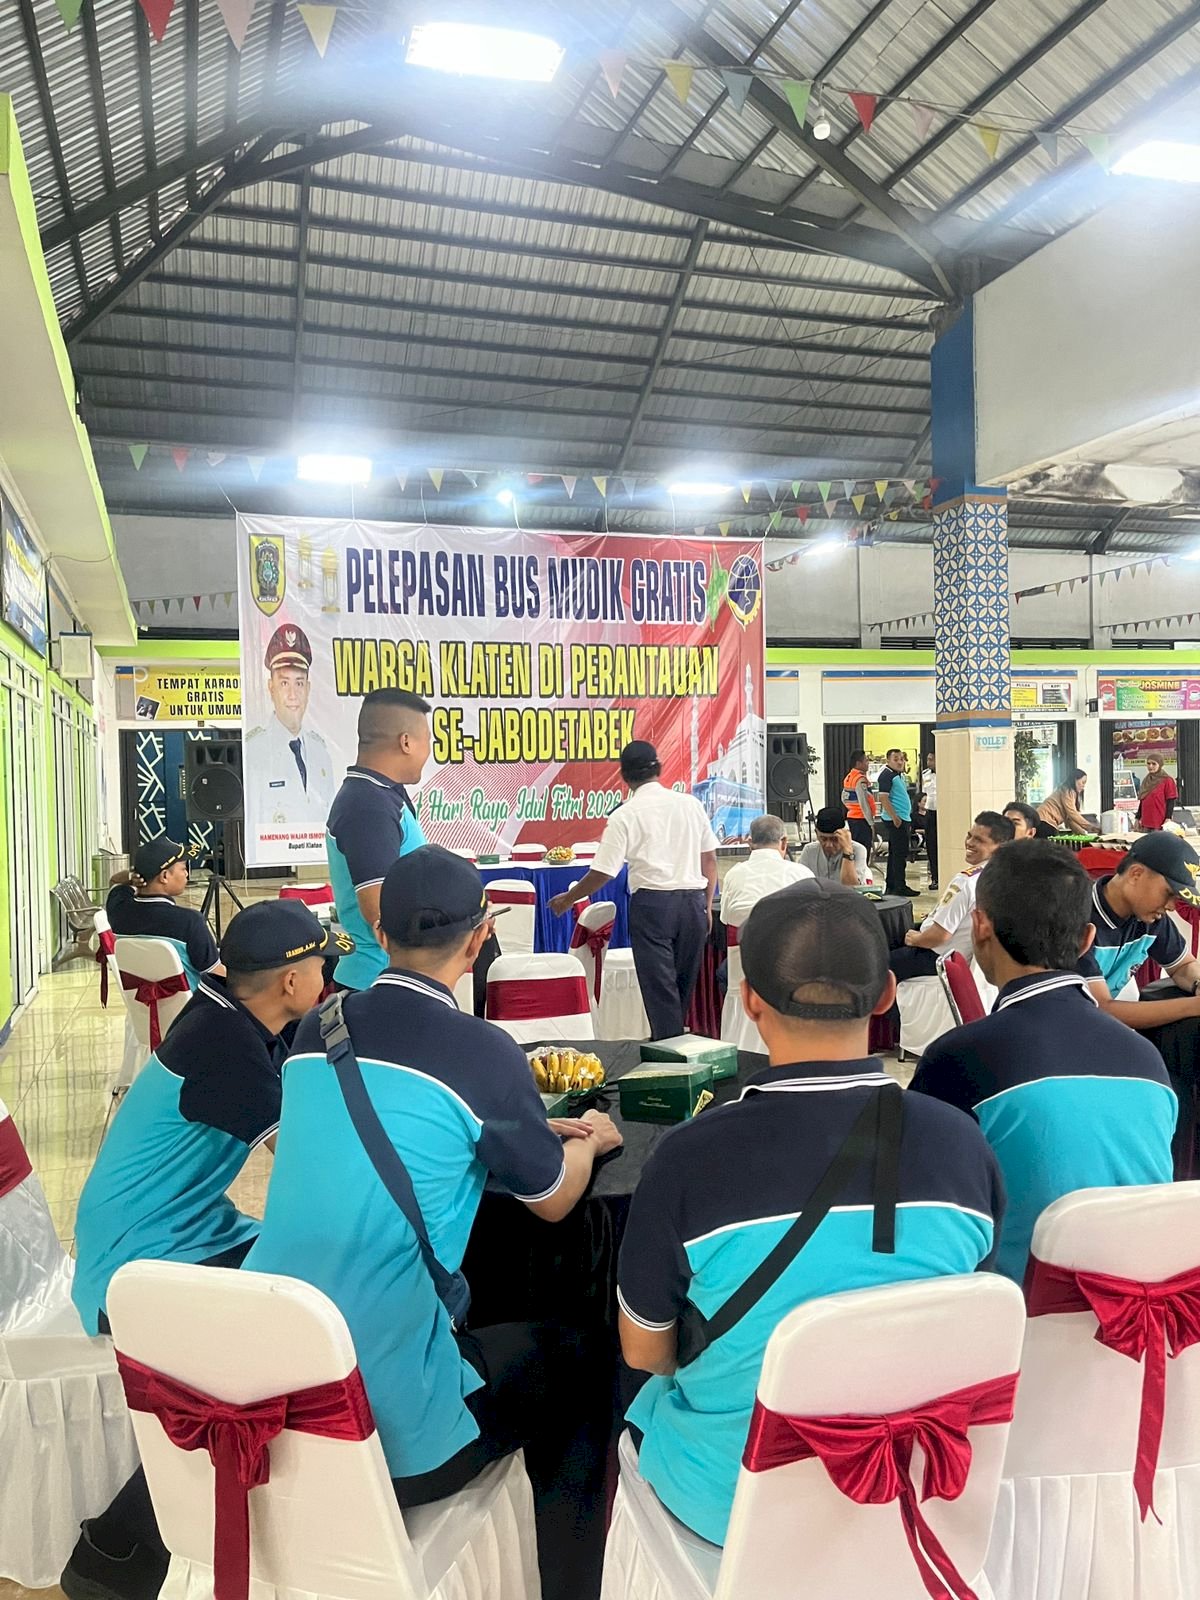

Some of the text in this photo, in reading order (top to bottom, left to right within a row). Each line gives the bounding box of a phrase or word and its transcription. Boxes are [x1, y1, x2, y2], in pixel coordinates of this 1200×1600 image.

[346, 547, 706, 623] PELEPASAN BUS MUDIK GRATIS
[333, 638, 720, 698] WARGA KLATEN DI PERANTAUAN
[157, 678, 242, 690] TEMPAT KARAO
[1140, 680, 1180, 691] JASMINE
[187, 691, 225, 703] GRATIS
[169, 704, 242, 716] UNTUK UMUM
[432, 706, 635, 764] SE-JABODETABEK
[976, 735, 1008, 746] TOILET
[428, 789, 465, 821] Hari
[469, 788, 509, 832] Raya
[515, 787, 549, 820] Idul
[551, 784, 585, 819] Fitri
[586, 790, 621, 817] 2026
[308, 832, 326, 840] ISMOY
